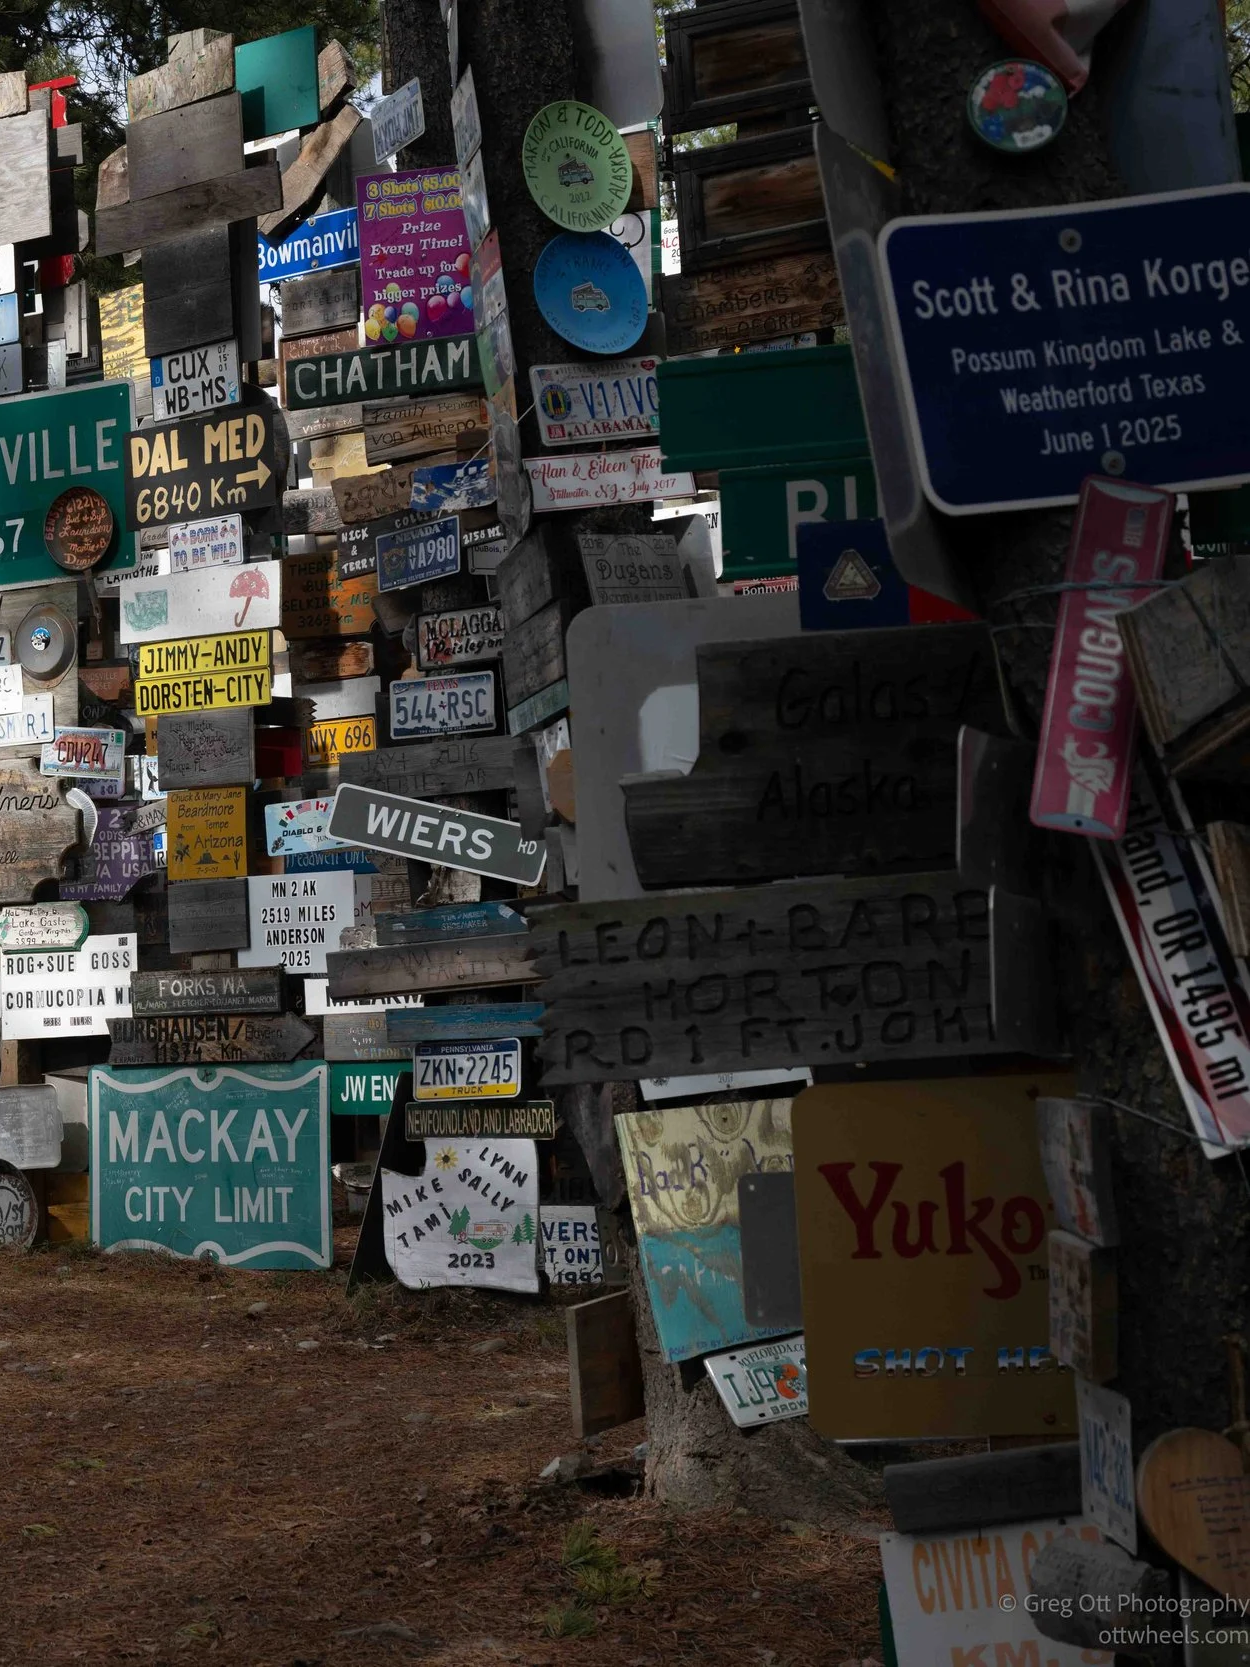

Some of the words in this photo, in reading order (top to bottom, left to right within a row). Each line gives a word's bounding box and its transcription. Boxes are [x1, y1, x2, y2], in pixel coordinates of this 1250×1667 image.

[576, 107, 614, 146] TODD
[526, 111, 552, 179] MARION
[608, 146, 628, 200] ALASKA
[367, 182, 379, 199] 3
[381, 179, 419, 199] Shots
[364, 202, 375, 221] 7
[378, 199, 417, 220] Shots
[538, 194, 618, 229] CALIFORNIA
[401, 221, 442, 235] Prize
[369, 242, 414, 257] Every
[419, 234, 463, 251] Time!
[375, 266, 415, 280] Trade
[418, 265, 435, 277] up
[440, 260, 458, 274] for
[373, 286, 416, 303] bigger
[420, 281, 462, 299] prizes
[912, 278, 996, 319] Scott
[1011, 273, 1041, 311] &
[1050, 268, 1129, 304] Rina
[1143, 250, 1250, 298] Korge
[951, 346, 1036, 375] Possum
[1043, 335, 1148, 370] Kingdom
[1154, 327, 1212, 354] Lake
[1222, 320, 1243, 346] &
[168, 349, 211, 383] CUX
[294, 338, 470, 401] CHATHAM
[999, 377, 1133, 414] Weatherford
[1138, 373, 1206, 399] Texas
[573, 417, 646, 437] ALABAMA
[1040, 429, 1094, 457] June
[1101, 424, 1110, 449] 1
[1120, 415, 1183, 448] 2025
[130, 429, 188, 479] DAL
[203, 414, 266, 465] MED
[531, 463, 567, 488] Alan
[588, 460, 628, 480] Eileen
[136, 482, 201, 524] 6840
[210, 477, 247, 508] Km
[188, 525, 219, 545] BORN
[395, 524, 441, 544] NEVADA
[174, 552, 187, 566] TO
[192, 549, 206, 564] BE
[210, 542, 237, 560] WILD
[342, 557, 376, 574] TERRY
[596, 559, 674, 585] Dugans
[1068, 550, 1140, 732] COUGARS
[144, 636, 262, 674] JIMMY-ANDY
[140, 674, 265, 711] DORSTEN-CITY
[425, 678, 459, 691] TEXAS
[309, 731, 337, 751] NVX
[344, 726, 371, 747] 696
[178, 803, 234, 818] Beardmore
[194, 834, 243, 849] Arizona
[367, 803, 495, 860] WIERS
[517, 839, 538, 856] RD
[272, 883, 286, 897] MN
[291, 882, 297, 894] 2
[303, 881, 317, 896] AK
[262, 908, 290, 923] 2519
[298, 905, 335, 922] MILES
[266, 929, 325, 946] ANDERSON
[1153, 908, 1208, 961] OR
[91, 951, 131, 970] GOSS
[281, 951, 311, 966] 2025
[6, 988, 105, 1009] CORNUCOPIA
[644, 948, 972, 1022] HORTON
[1172, 962, 1244, 1049] 1495
[441, 1044, 494, 1054] PENNSYLVANIA
[341, 1076, 367, 1102] JW
[452, 1086, 483, 1095] TRUCK
[407, 1109, 481, 1135] NEWFOUNDLAND
[483, 1109, 501, 1134] AND
[504, 1108, 552, 1134] LABRADOR
[108, 1108, 310, 1163] MACKAY
[478, 1146, 529, 1189] LYNN
[386, 1177, 444, 1218] MIKE
[458, 1168, 515, 1213] SALLY
[124, 1186, 195, 1223] CITY
[214, 1186, 293, 1224] LIMIT
[816, 1159, 1053, 1300] Yuko
[448, 1252, 495, 1268] 2023
[853, 1345, 972, 1379] SHOT
[912, 1536, 1015, 1615] CIVITA
